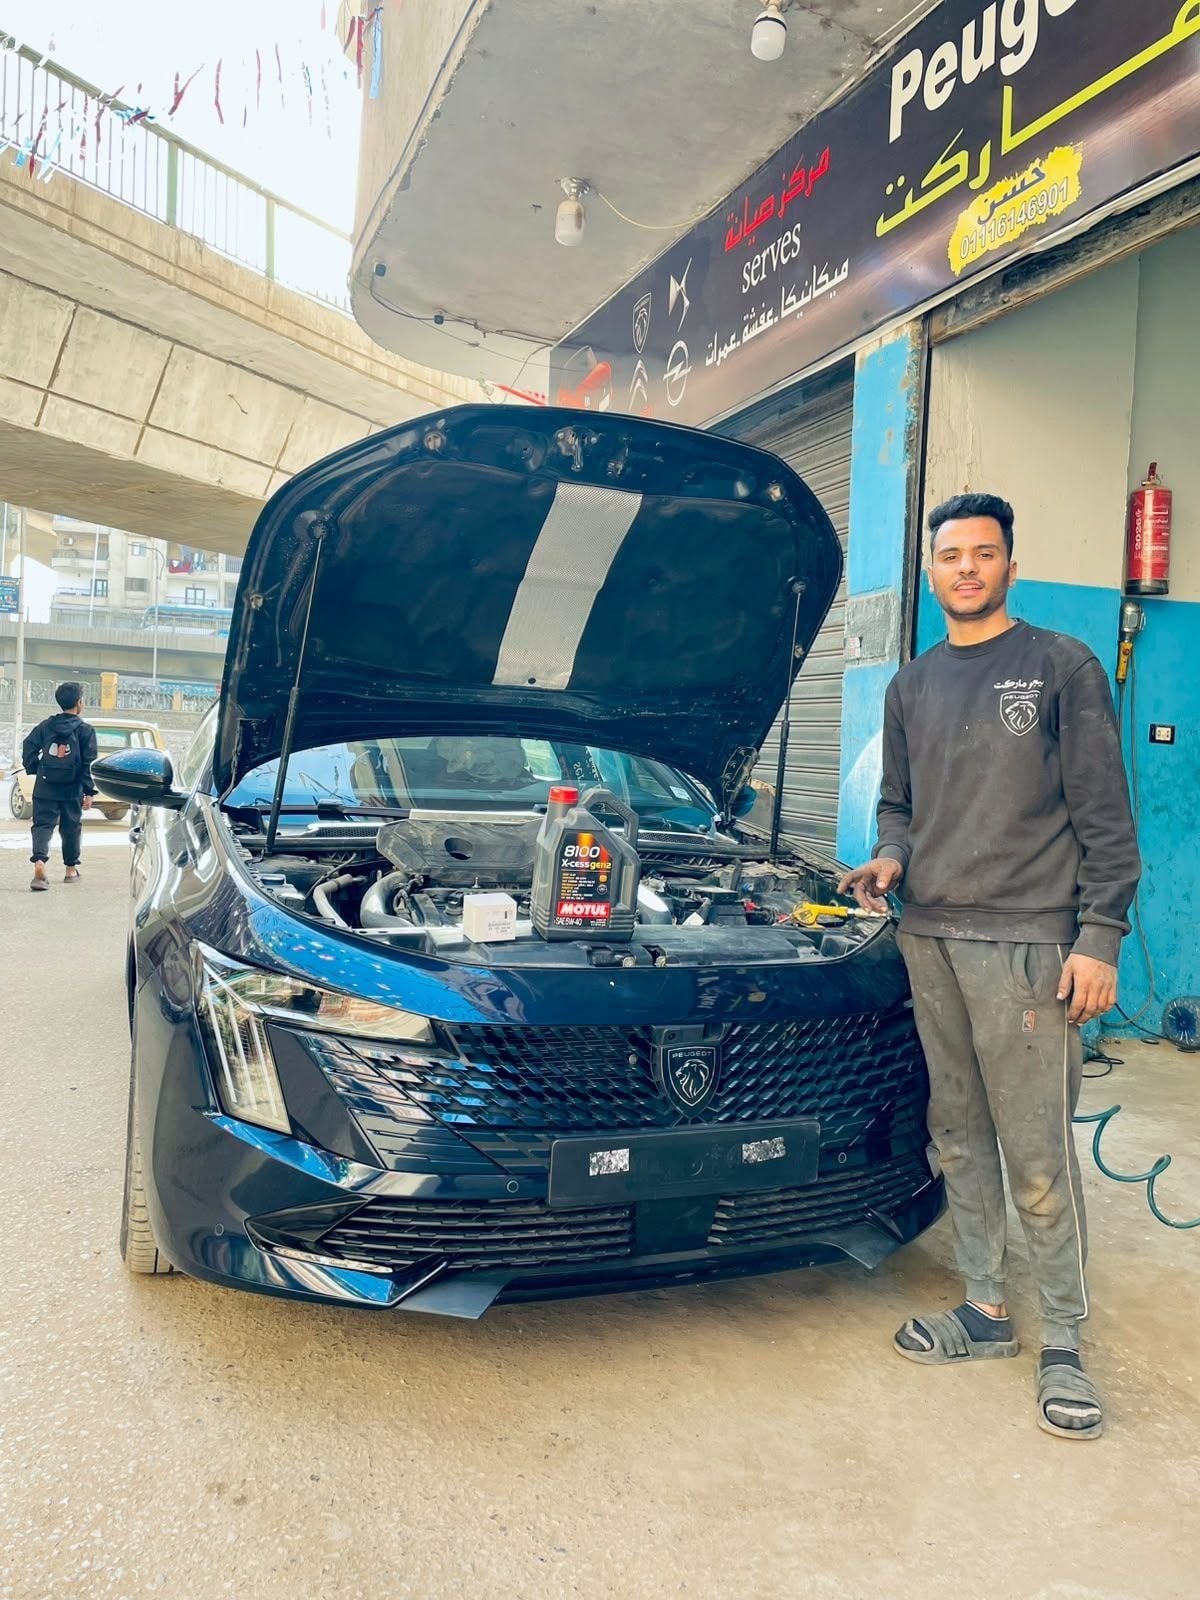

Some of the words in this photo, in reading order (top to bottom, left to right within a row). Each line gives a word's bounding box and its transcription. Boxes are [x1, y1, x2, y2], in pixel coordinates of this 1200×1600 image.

[889, 0, 1078, 143] Peug
[778, 146, 831, 218] مركز
[978, 167, 1046, 225] حسن
[725, 196, 776, 252] صيانة
[960, 177, 1069, 259] 01116146901
[742, 223, 801, 293] serves
[561, 858, 590, 868] X-cess
[564, 845, 600, 858] 8100
[560, 903, 607, 915] MOTUL
[672, 1050, 712, 1058] PEUGEOT
